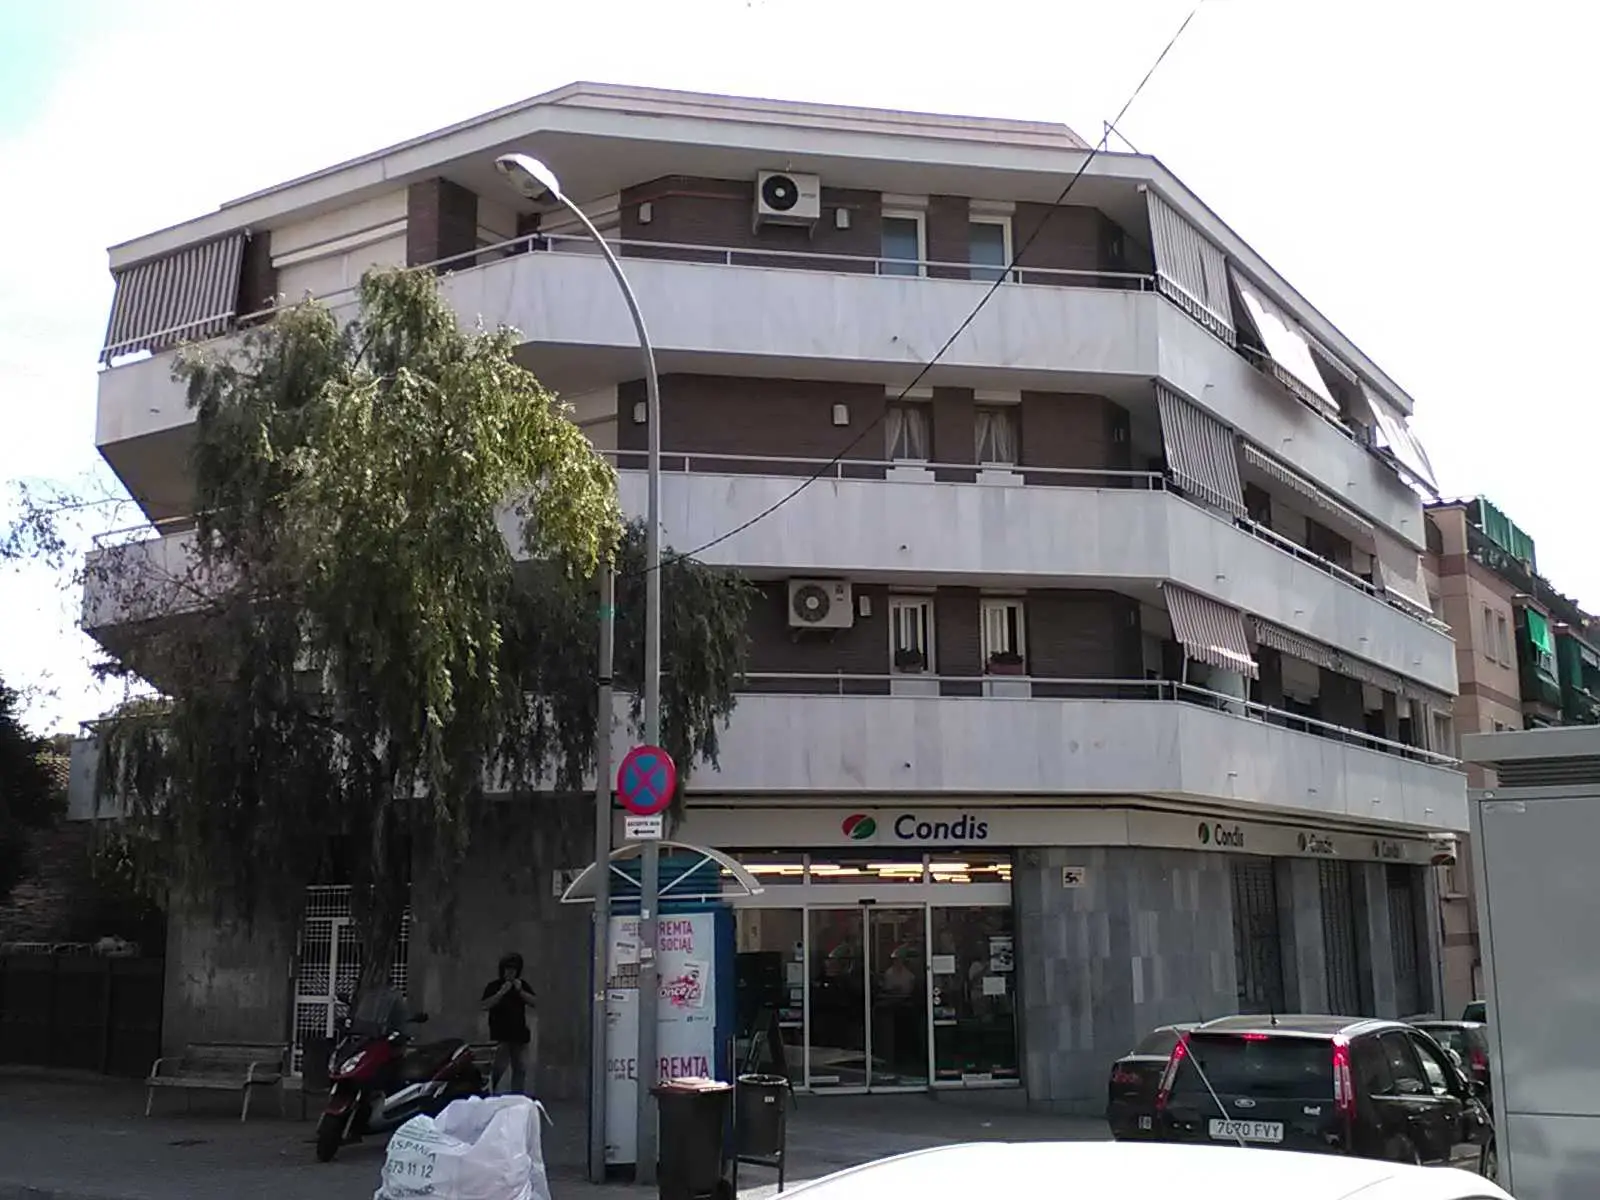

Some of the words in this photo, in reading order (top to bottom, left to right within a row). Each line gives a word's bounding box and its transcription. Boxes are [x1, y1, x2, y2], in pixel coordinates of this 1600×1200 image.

[894, 813, 989, 840] Condis
[1214, 823, 1244, 848] Condis
[656, 920, 694, 936] REMTA
[660, 937, 694, 954] SOCIAL
[1254, 1123, 1280, 1138] FVY
[420, 1164, 434, 1179] 12
